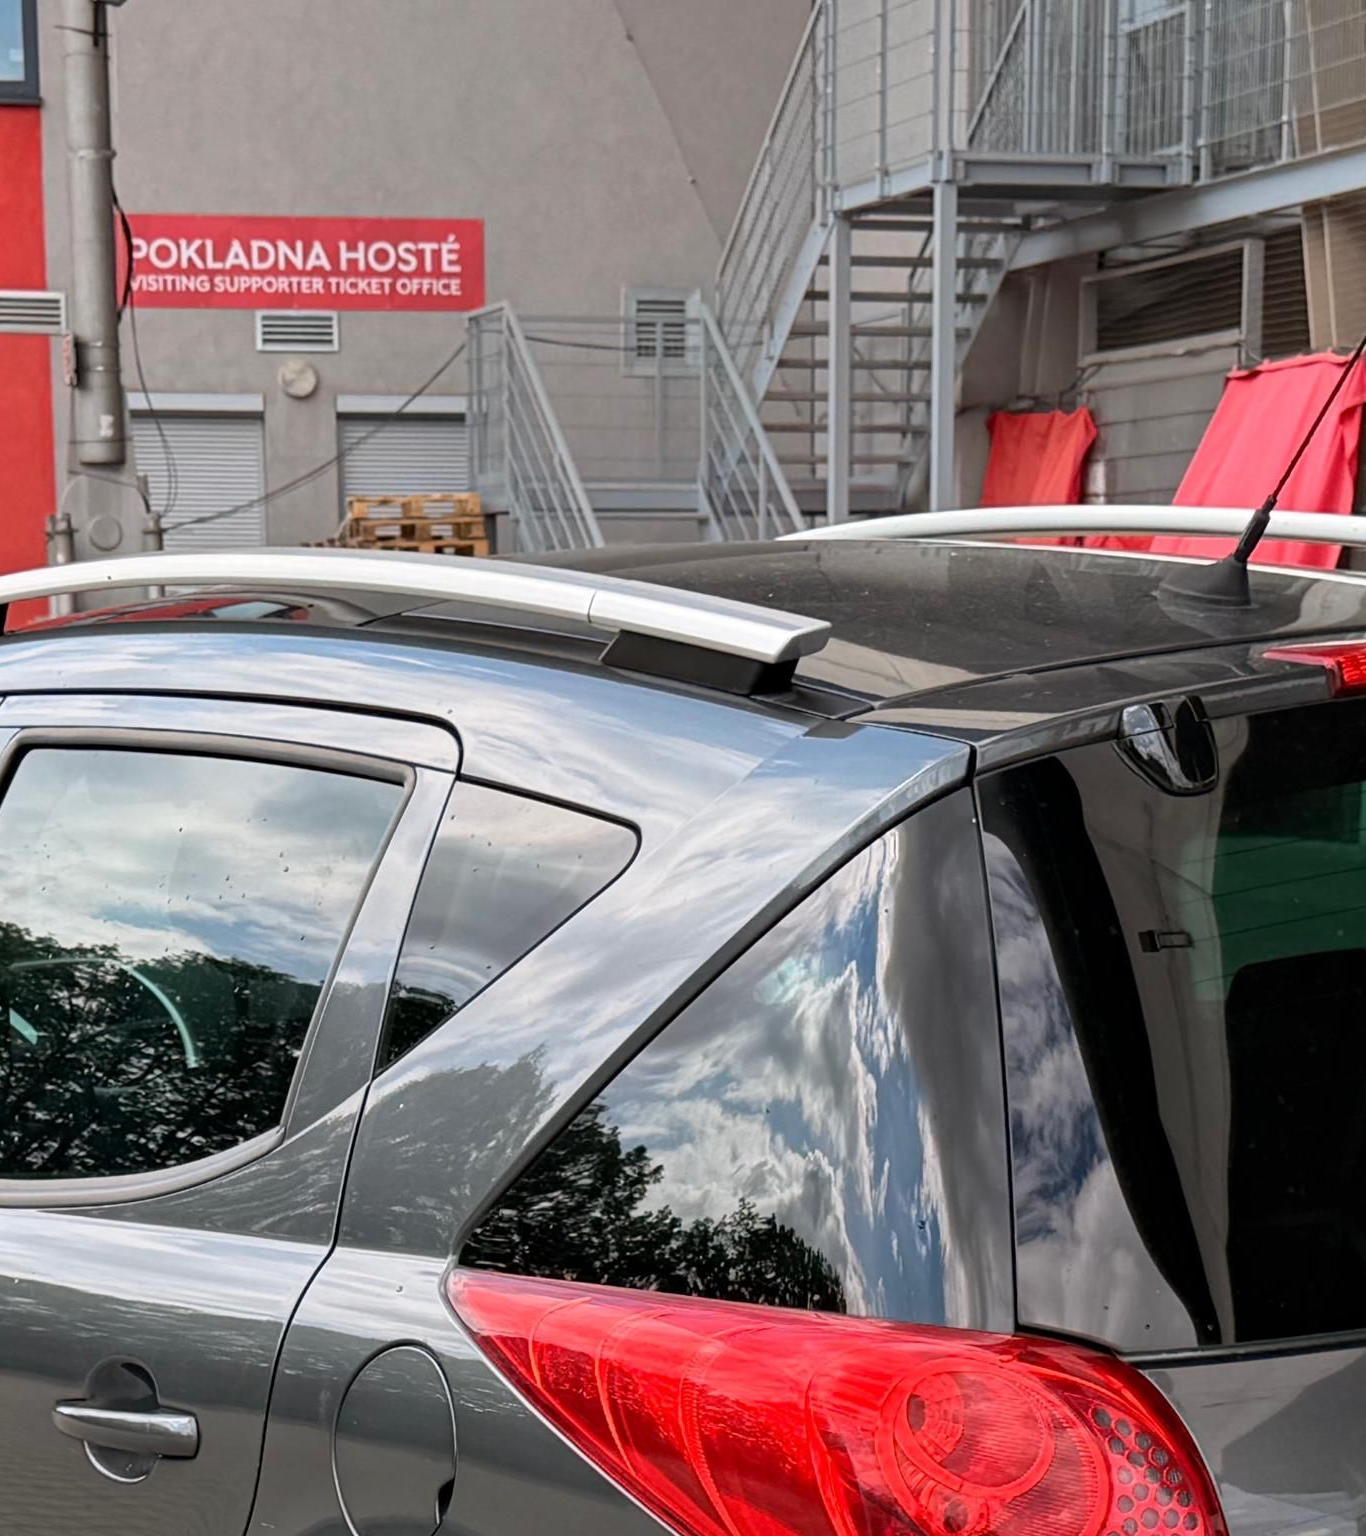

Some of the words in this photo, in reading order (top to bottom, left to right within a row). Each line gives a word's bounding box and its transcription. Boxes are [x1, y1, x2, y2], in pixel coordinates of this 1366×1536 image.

[132, 237, 332, 271] POKLADNA
[339, 233, 462, 273] HOSTÉ
[130, 274, 210, 292] VISITING
[214, 275, 324, 294] SUPPORTER
[328, 277, 393, 295] TICKET
[395, 278, 462, 296] OFFICE
